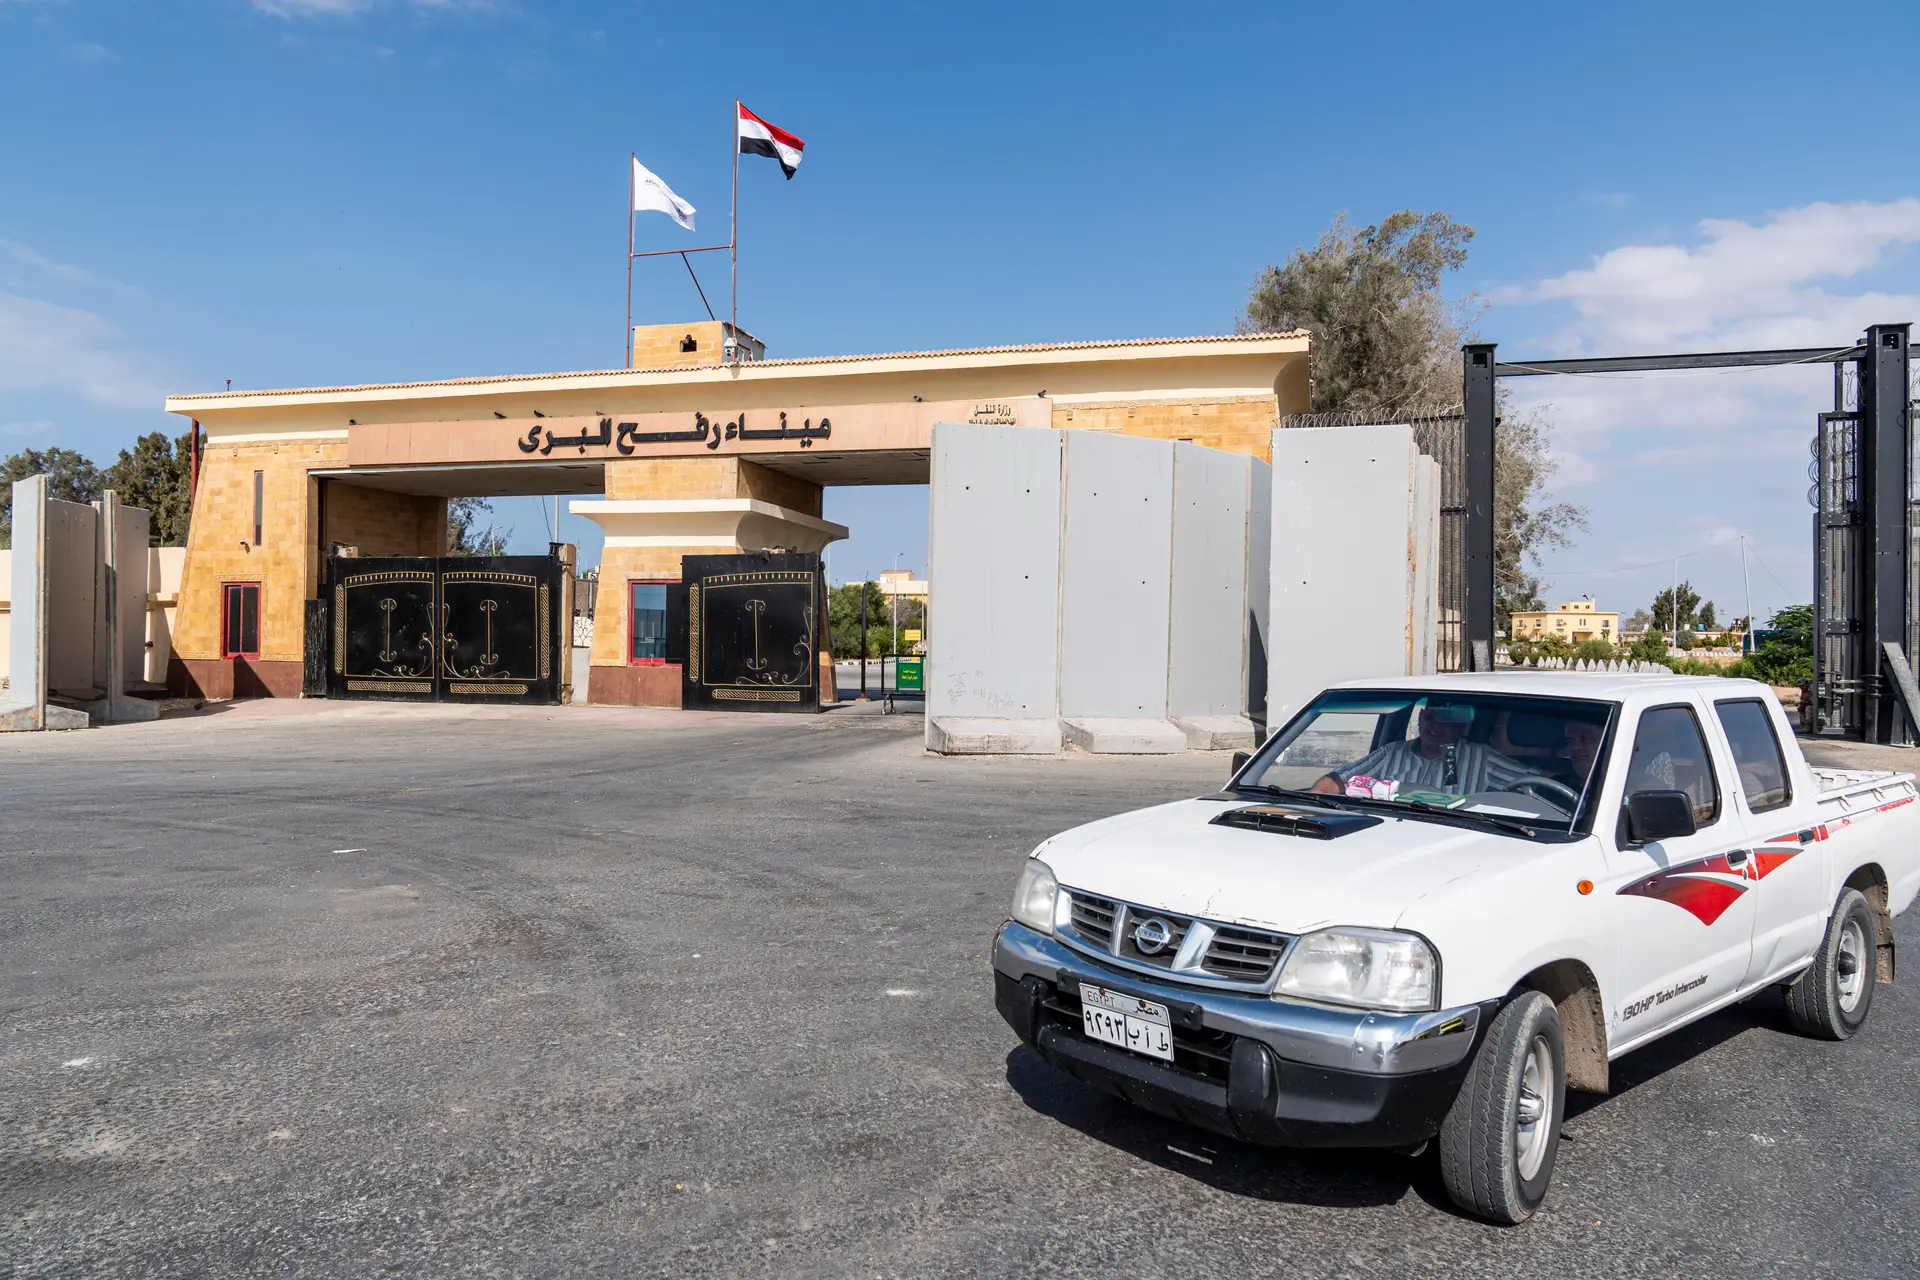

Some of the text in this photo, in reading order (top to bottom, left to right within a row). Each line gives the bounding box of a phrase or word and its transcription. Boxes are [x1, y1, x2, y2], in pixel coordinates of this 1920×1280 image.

[616, 411, 720, 455] رفح
[724, 411, 832, 449] ميناء
[1655, 989, 1675, 1006] Turbo
[1674, 974, 1709, 997] Intercooler
